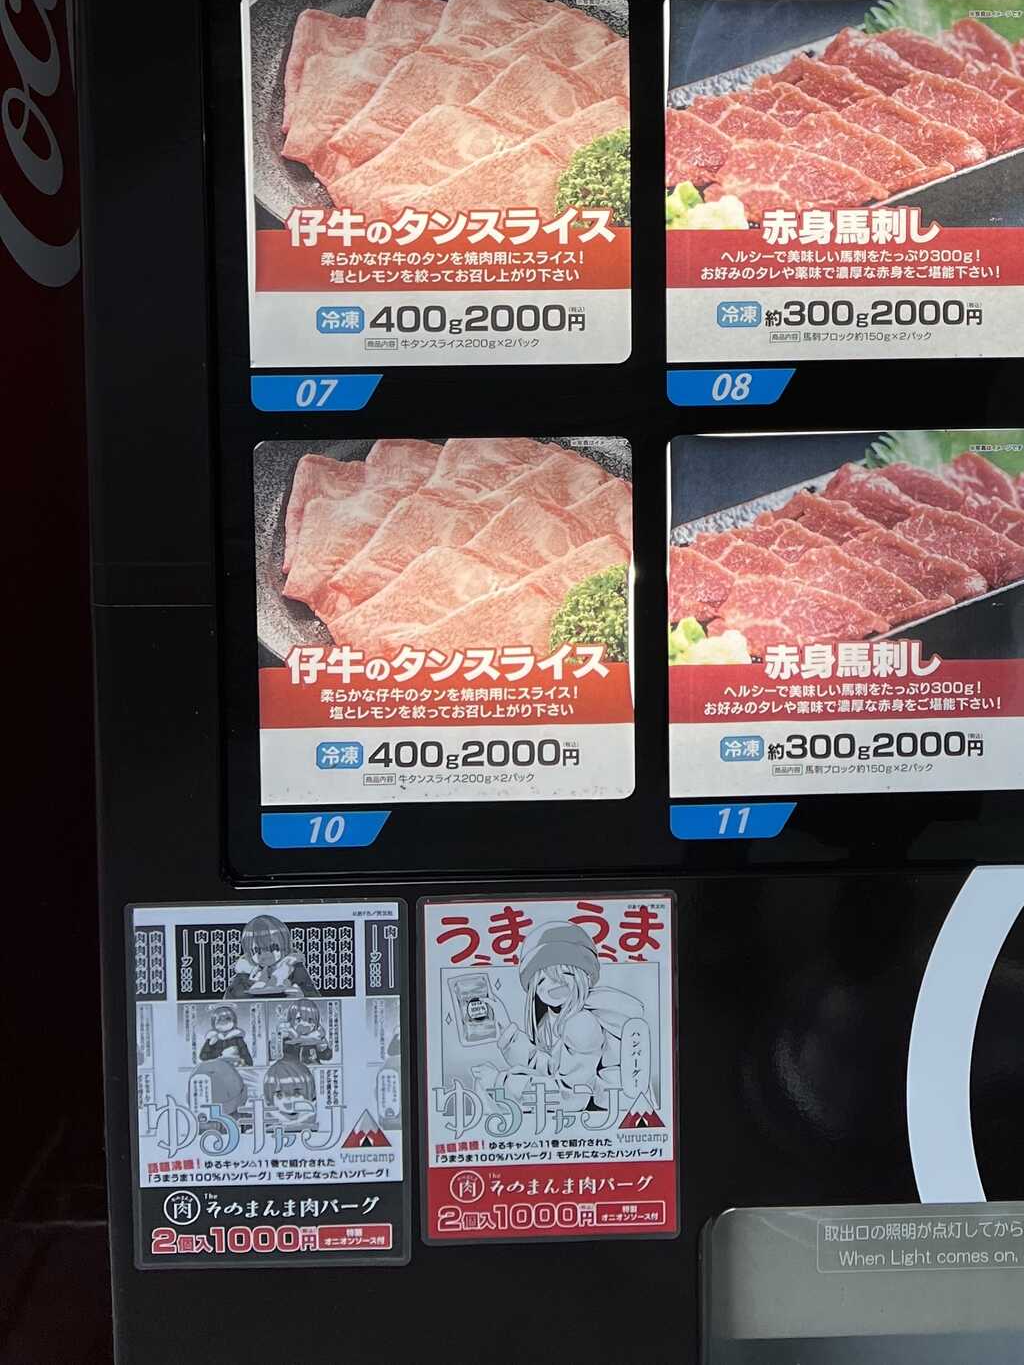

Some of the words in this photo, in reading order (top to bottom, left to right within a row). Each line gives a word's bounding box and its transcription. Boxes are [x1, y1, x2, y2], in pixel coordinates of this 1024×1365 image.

[286, 208, 616, 247] 仔牛のタンスライス
[762, 208, 943, 245] 赤身馬刺し
[321, 251, 584, 266] 柔らかな仔牛のタンを焼肉用にスライス!
[721, 249, 981, 264] ヘルシーで美味しい馬刺をたっぷり300g!
[330, 268, 579, 284] 塩とレモンを絞ってお召し上がり下さい
[701, 266, 1000, 280] お好みのタレや薬味で濃厚な赤身をご堪能下さい!
[321, 311, 360, 329] 冷凍
[721, 305, 757, 323] 冷凍
[296, 380, 338, 407] 07
[711, 374, 752, 401] 08
[286, 645, 610, 684] 仔牛のタンスライス
[765, 642, 941, 680] 赤身馬刺し
[321, 687, 578, 703] 柔らかな仔牛のタンを焼肉用にスライス!
[724, 681, 982, 697] ヘルシーで美味しい馬刺をたっぷり300g!
[329, 704, 574, 720] 塩とレモンを絞ってお召し上がり下さい
[704, 697, 1001, 715] お好みのタレや薬味で濃厚な赤身をご堪能下さい!
[321, 746, 359, 765] 冷凍
[725, 740, 760, 758] 冷凍
[719, 807, 750, 834] 11
[309, 816, 345, 844] 10
[436, 905, 533, 964] うま
[617, 1134, 669, 1144] Yurucamp
[340, 1153, 395, 1164] Yurucamp
[490, 1175, 653, 1196] そのまんま肉バーグ
[206, 1196, 380, 1218] そのまんま肉バーグ
[438, 1202, 596, 1232] 2個入1000円
[152, 1225, 319, 1254] 2個入1000円
[839, 1249, 886, 1266] When
[890, 1248, 931, 1266] Light
[937, 1250, 989, 1265] comes
